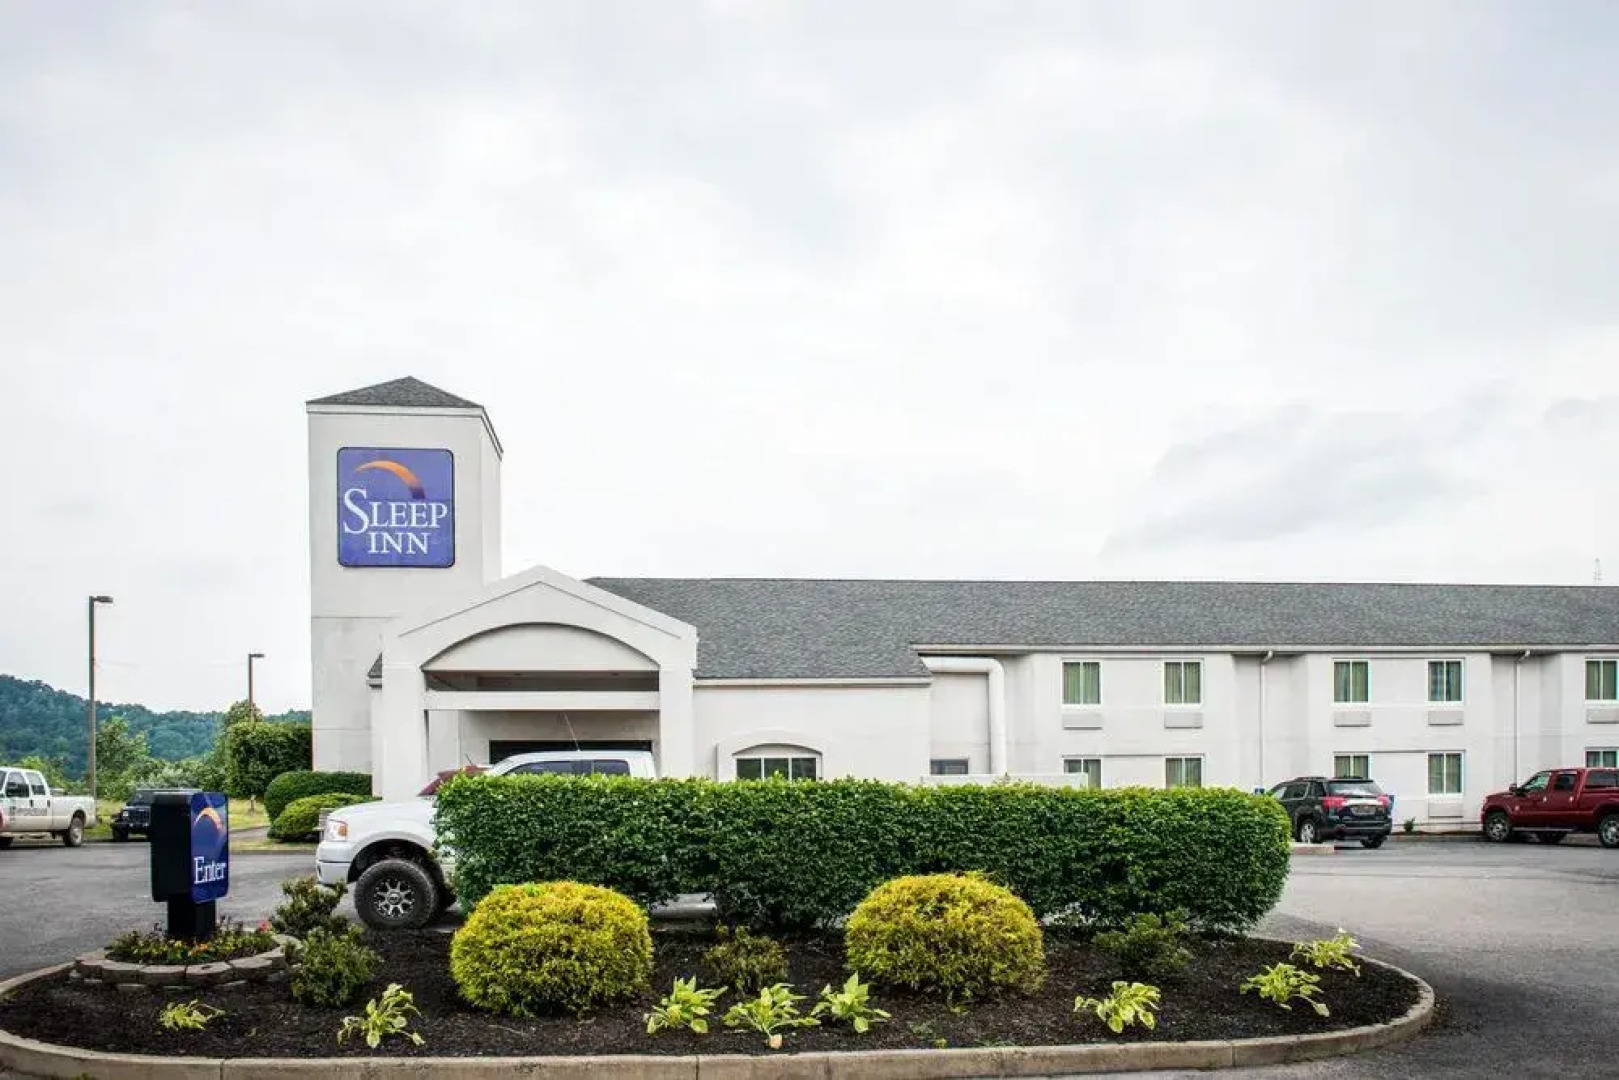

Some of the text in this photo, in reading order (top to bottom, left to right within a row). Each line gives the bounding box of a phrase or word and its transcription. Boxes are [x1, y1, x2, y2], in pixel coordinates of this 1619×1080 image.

[343, 488, 448, 534] SLEEP
[368, 531, 431, 554] INN
[194, 856, 226, 884] Enter
